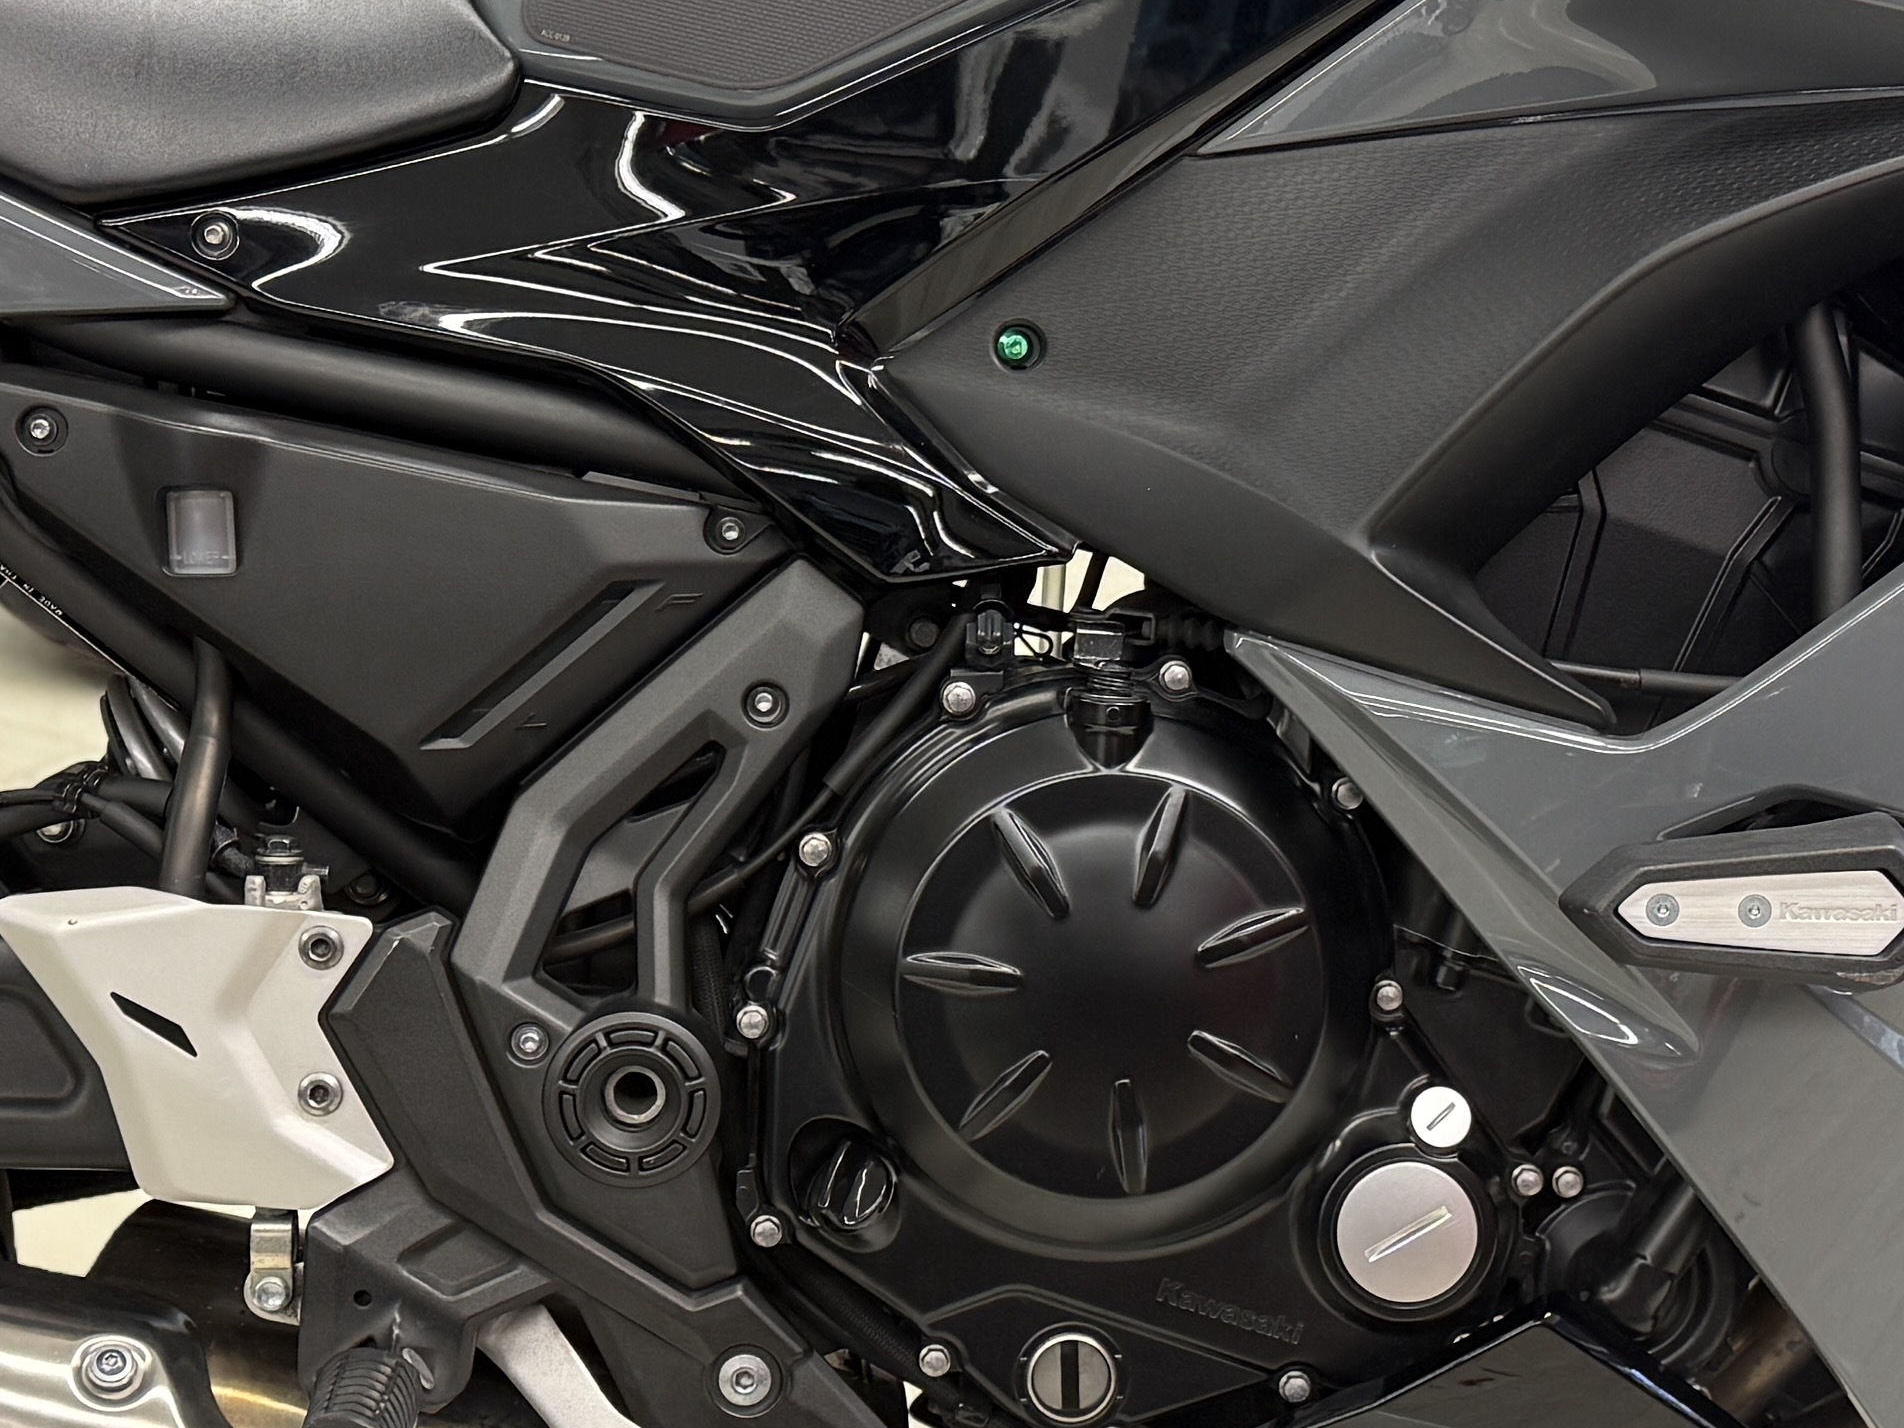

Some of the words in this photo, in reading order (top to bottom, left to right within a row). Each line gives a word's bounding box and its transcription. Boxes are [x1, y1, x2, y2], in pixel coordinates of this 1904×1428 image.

[22, 583, 34, 593] IN
[39, 595, 63, 616] MADE
[1778, 901, 1897, 923] Kawasaki
[1155, 1277, 1305, 1345] Kawasaki
